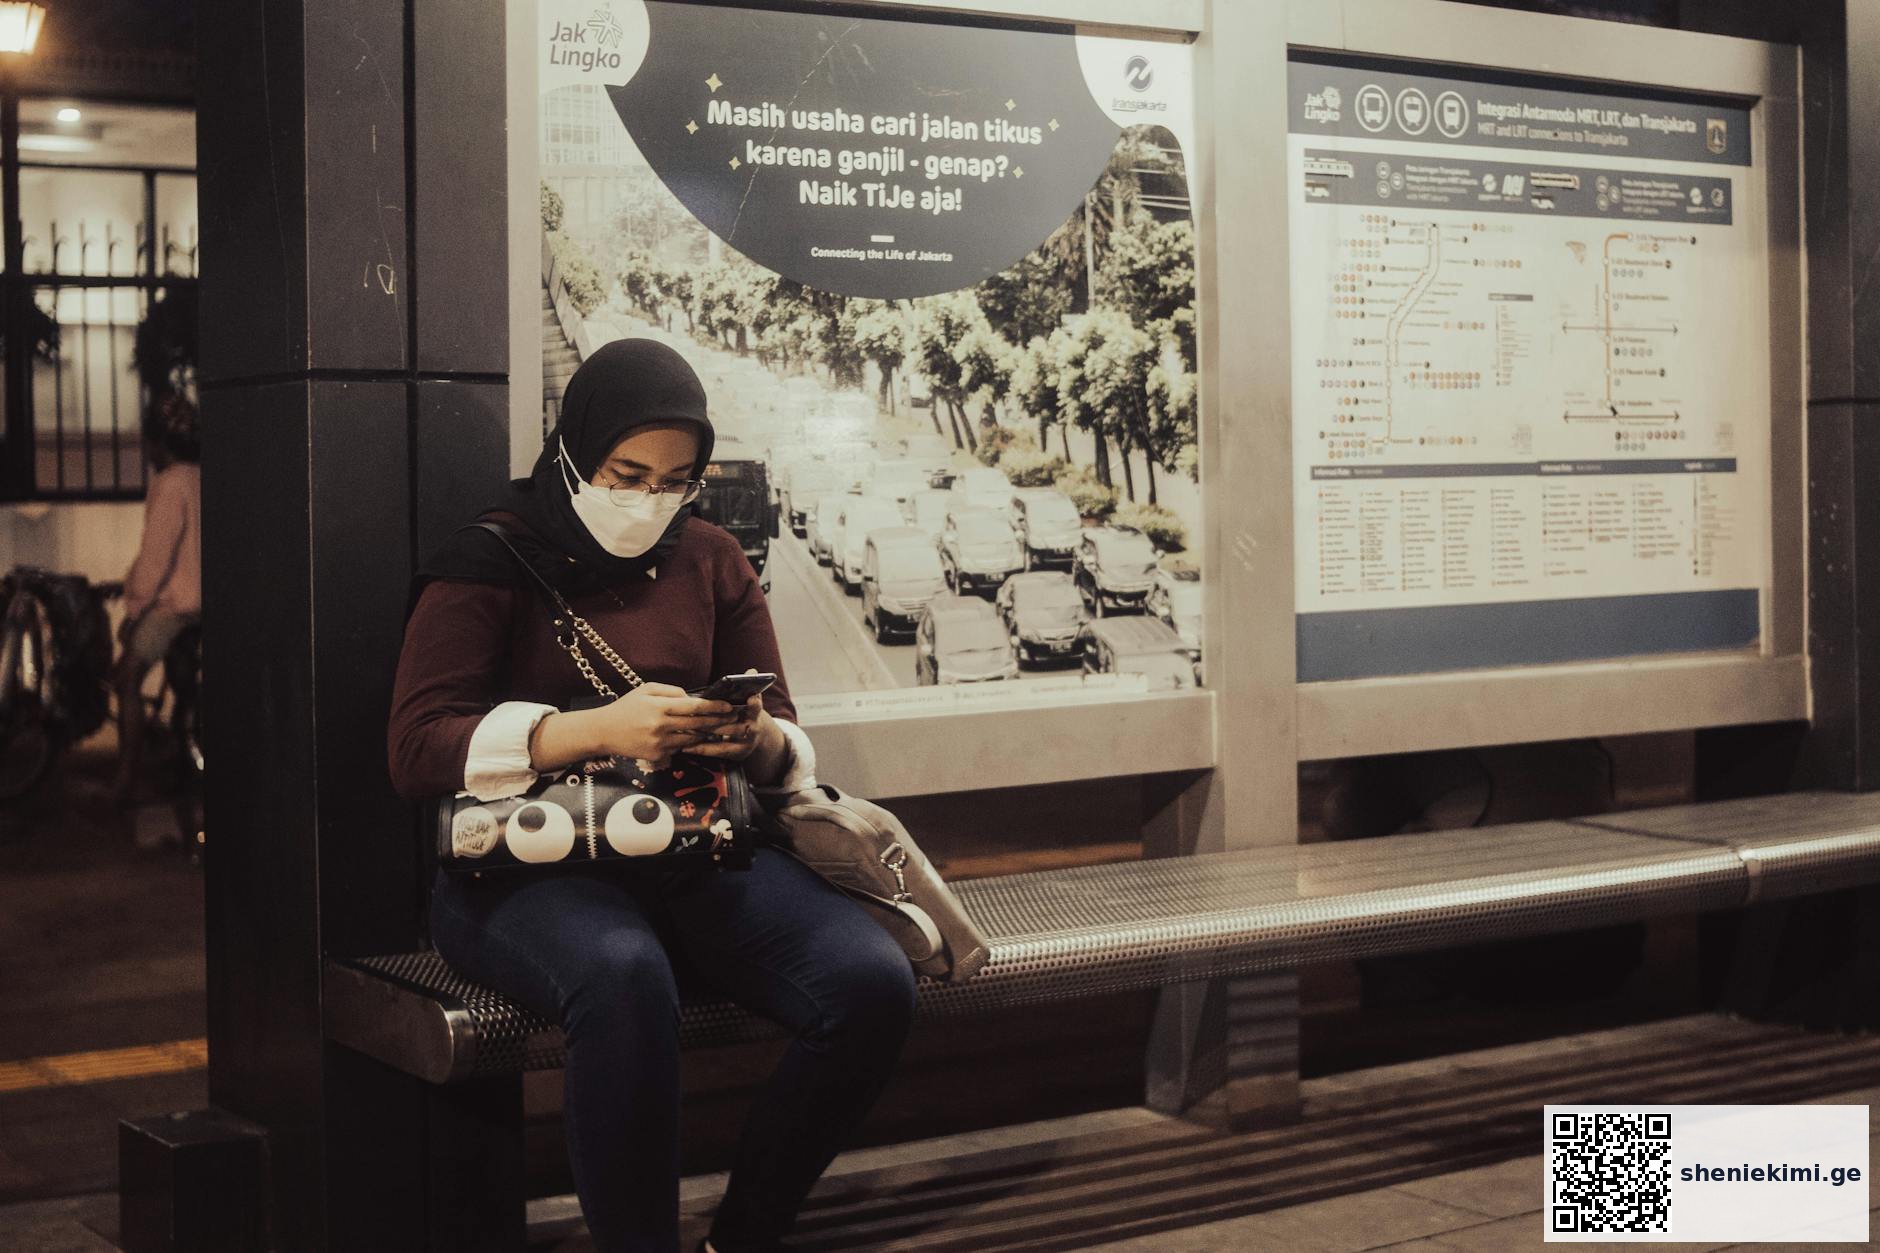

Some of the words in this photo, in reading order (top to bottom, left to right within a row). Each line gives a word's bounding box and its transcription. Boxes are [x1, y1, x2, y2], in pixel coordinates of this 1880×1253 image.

[549, 21, 587, 43] Jak
[550, 43, 621, 72] Lingko
[707, 100, 785, 128] Masih
[791, 108, 865, 133] usaha
[870, 112, 916, 137] cari
[921, 113, 979, 143] jalan
[984, 118, 1042, 145] tikus
[1304, 105, 1340, 124] Lingko
[1477, 99, 1521, 121] Integrasi
[1622, 113, 1641, 128] dan
[746, 140, 832, 168] karena
[838, 147, 904, 177] ganjil
[910, 159, 919, 167] -
[924, 155, 1009, 183] genap?
[799, 180, 857, 207] Naik
[861, 183, 915, 209] TiJe
[920, 186, 962, 215] aja!
[811, 247, 866, 261] Connecting
[867, 249, 884, 259] the
[885, 249, 904, 261] Life
[905, 250, 917, 260] of
[918, 251, 953, 262] Jakarta
